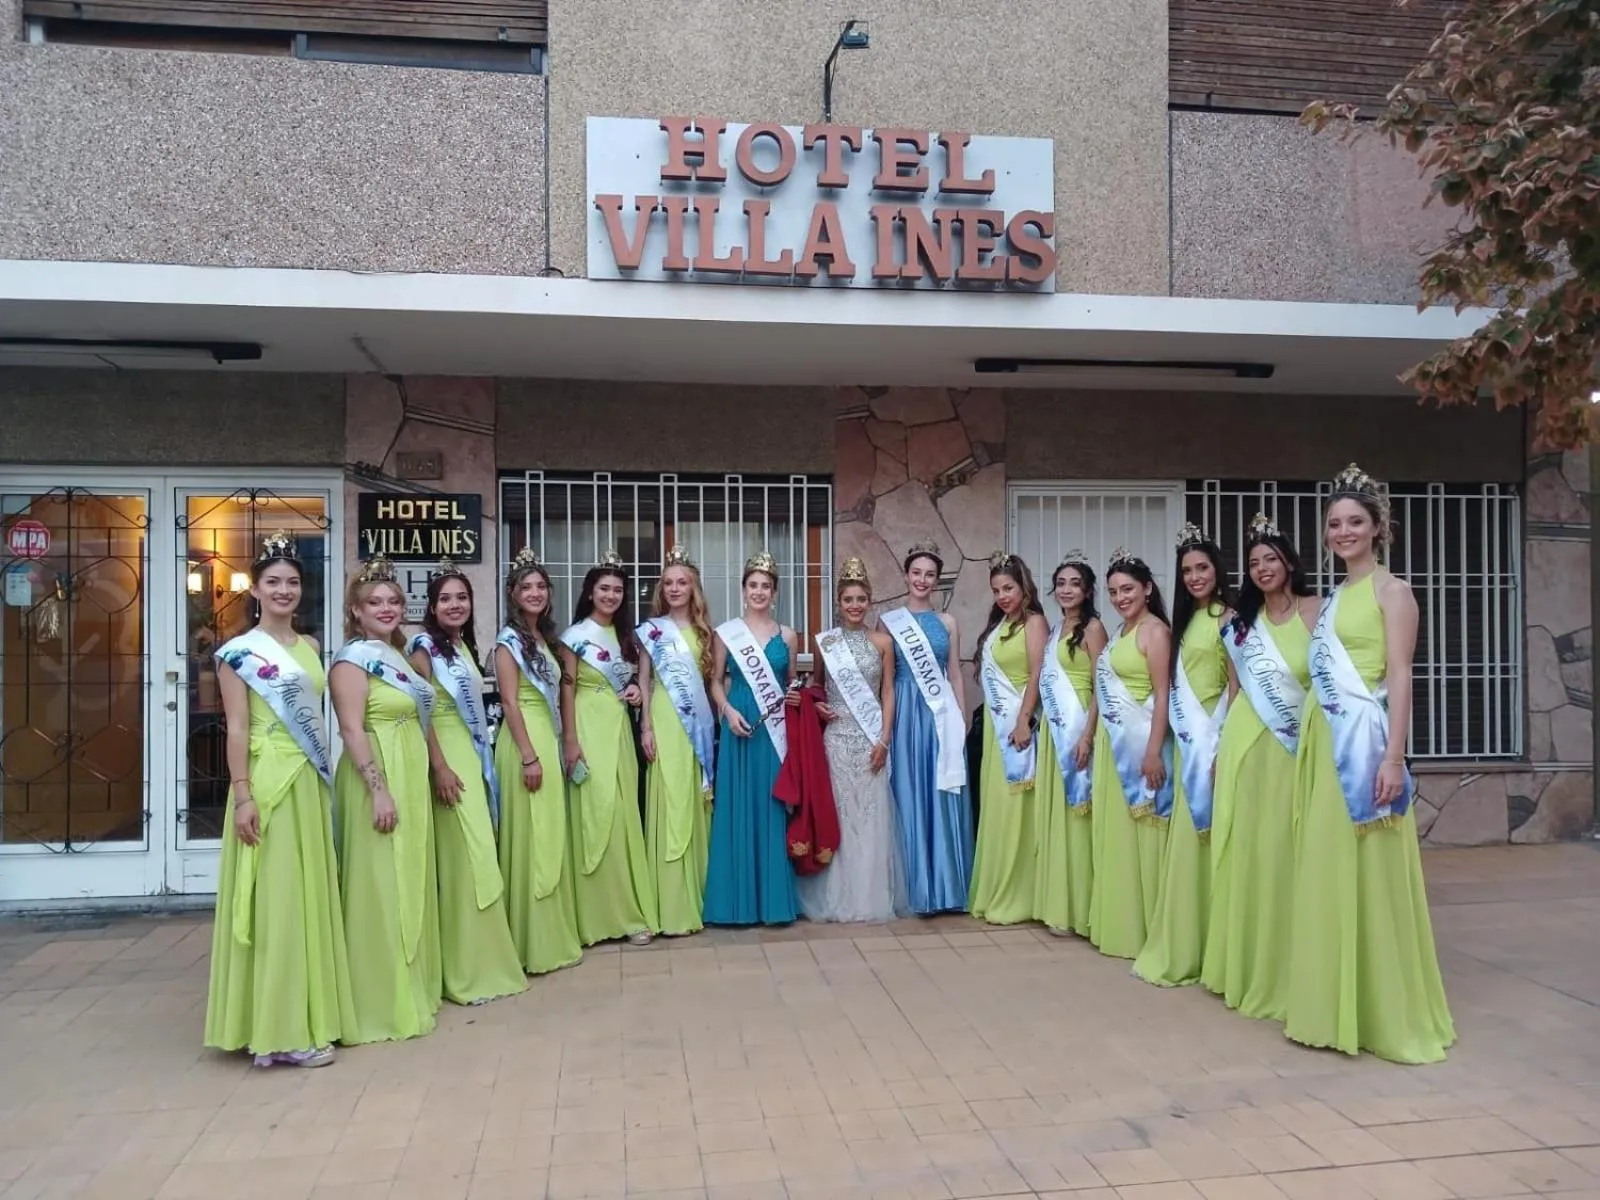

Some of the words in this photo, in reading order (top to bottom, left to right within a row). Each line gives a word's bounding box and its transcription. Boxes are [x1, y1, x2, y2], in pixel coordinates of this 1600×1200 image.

[659, 115, 996, 195] HOTEL
[593, 194, 856, 281] VILLA
[869, 204, 1057, 289] INES
[12, 531, 47, 549] MPA
[365, 528, 424, 554] VILLA
[431, 526, 476, 555] INÉS
[377, 500, 467, 520] HOTEL
[739, 645, 785, 728] BONARDA
[899, 625, 942, 698] TURISMO
